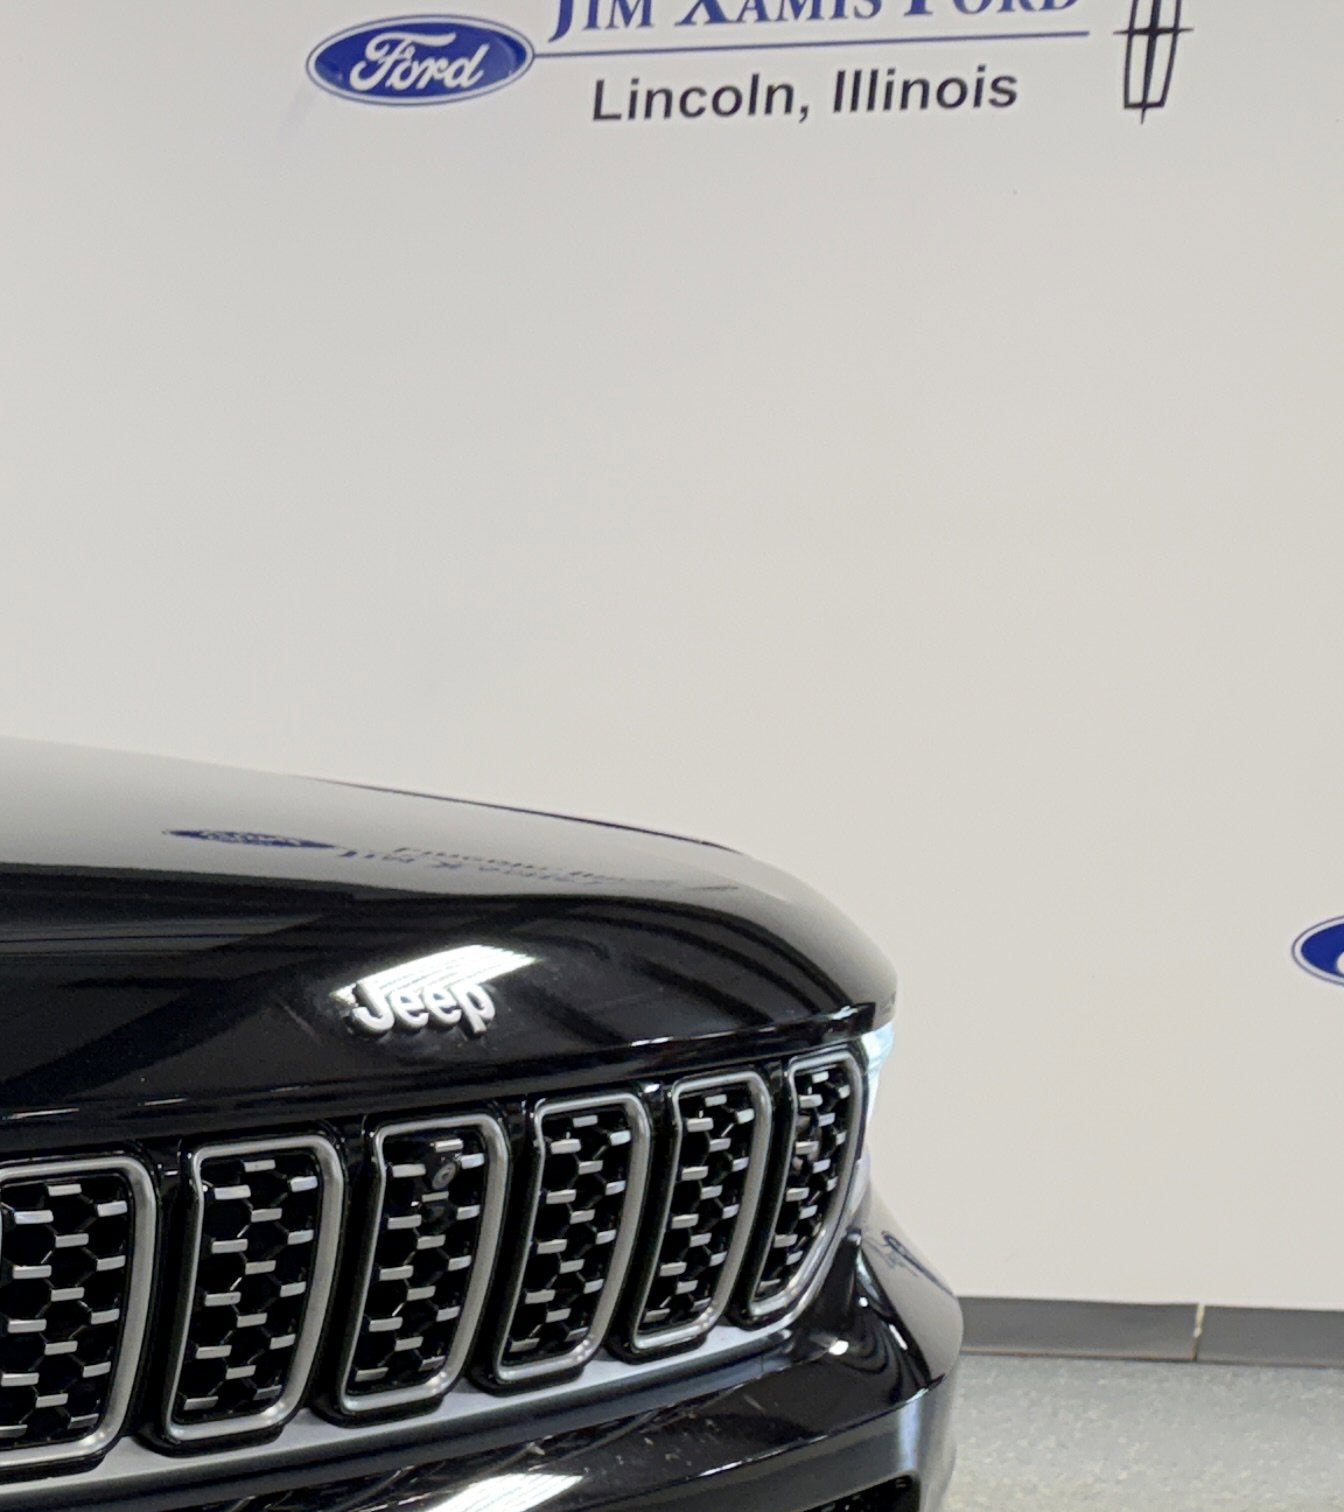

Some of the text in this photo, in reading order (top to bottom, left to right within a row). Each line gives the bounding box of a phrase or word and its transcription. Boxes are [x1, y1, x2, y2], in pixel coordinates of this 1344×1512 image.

[349, 31, 491, 91] Ford
[591, 65, 1019, 123] Lincoln, Illinois
[351, 980, 496, 1035] Jeep
